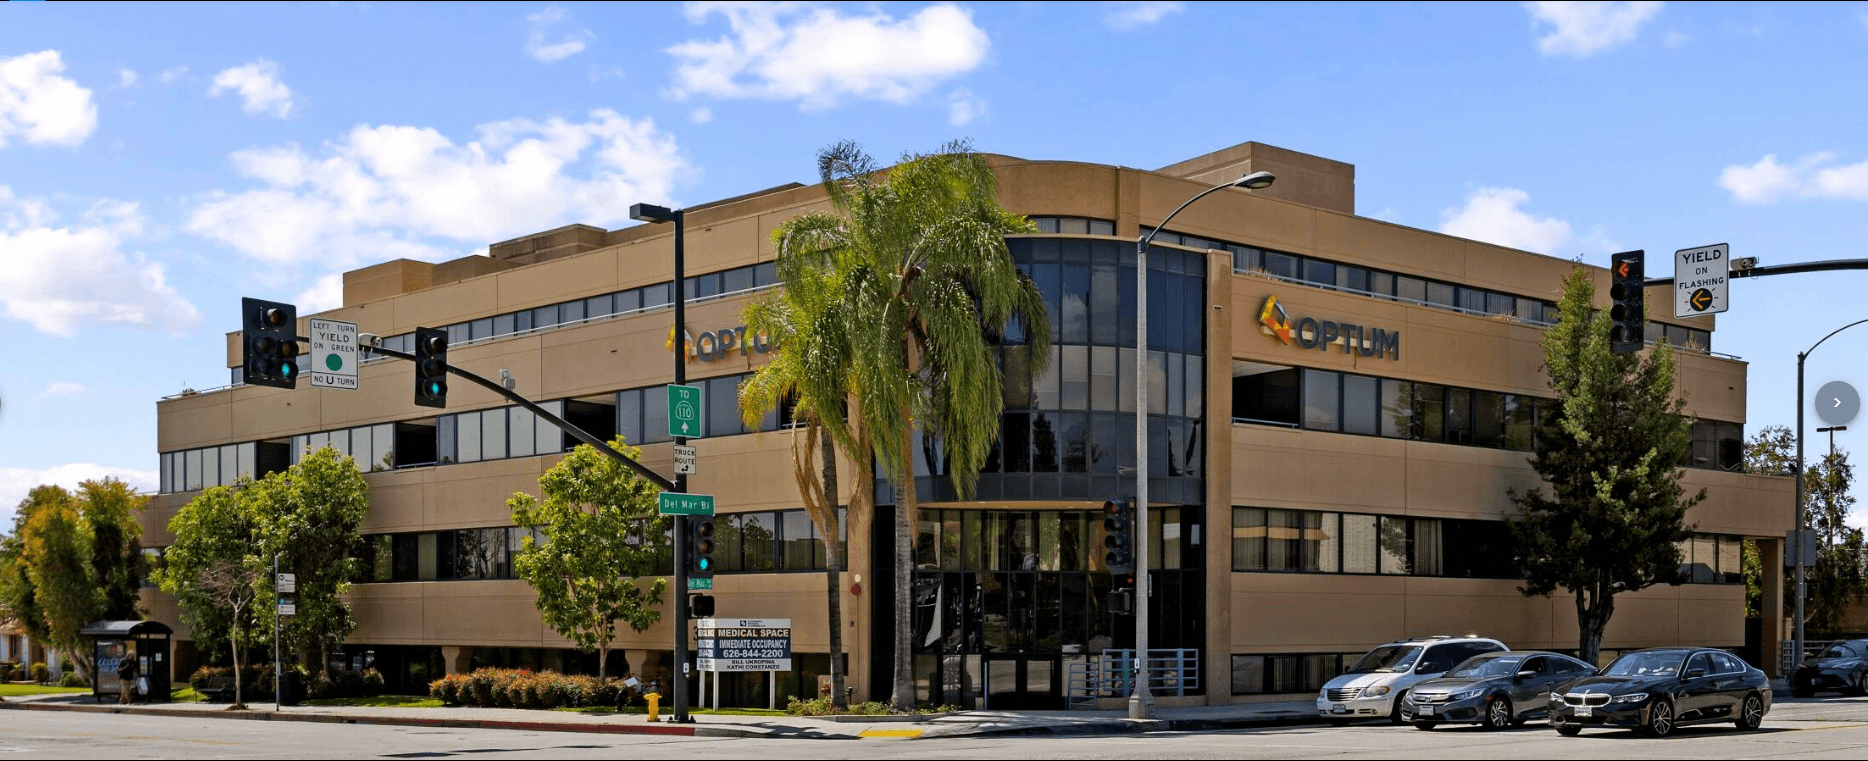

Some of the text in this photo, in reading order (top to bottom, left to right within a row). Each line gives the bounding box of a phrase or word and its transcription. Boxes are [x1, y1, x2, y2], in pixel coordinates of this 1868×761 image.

[1683, 249, 1722, 264] YIELD
[1695, 266, 1708, 275] ON
[1679, 276, 1724, 290] FLASHING
[313, 322, 355, 333] LEFT TURN
[319, 332, 350, 343] YIELD
[1295, 317, 1400, 361] OPTUM
[313, 342, 355, 353] ON GREEN
[697, 326, 771, 362] OPTU
[326, 375, 334, 385] U
[337, 378, 355, 386] TURN
[679, 389, 690, 399] TO
[678, 407, 692, 419] 110
[674, 457, 696, 465] ROUTE
[664, 498, 678, 509] Del
[681, 500, 698, 509] Mar
[718, 629, 758, 637] MEDICAL
[760, 629, 789, 637] SPACE
[719, 639, 751, 649] IMMEDIATE
[752, 639, 787, 649] OCCUPANCY
[723, 649, 783, 658] 626-844-2200
